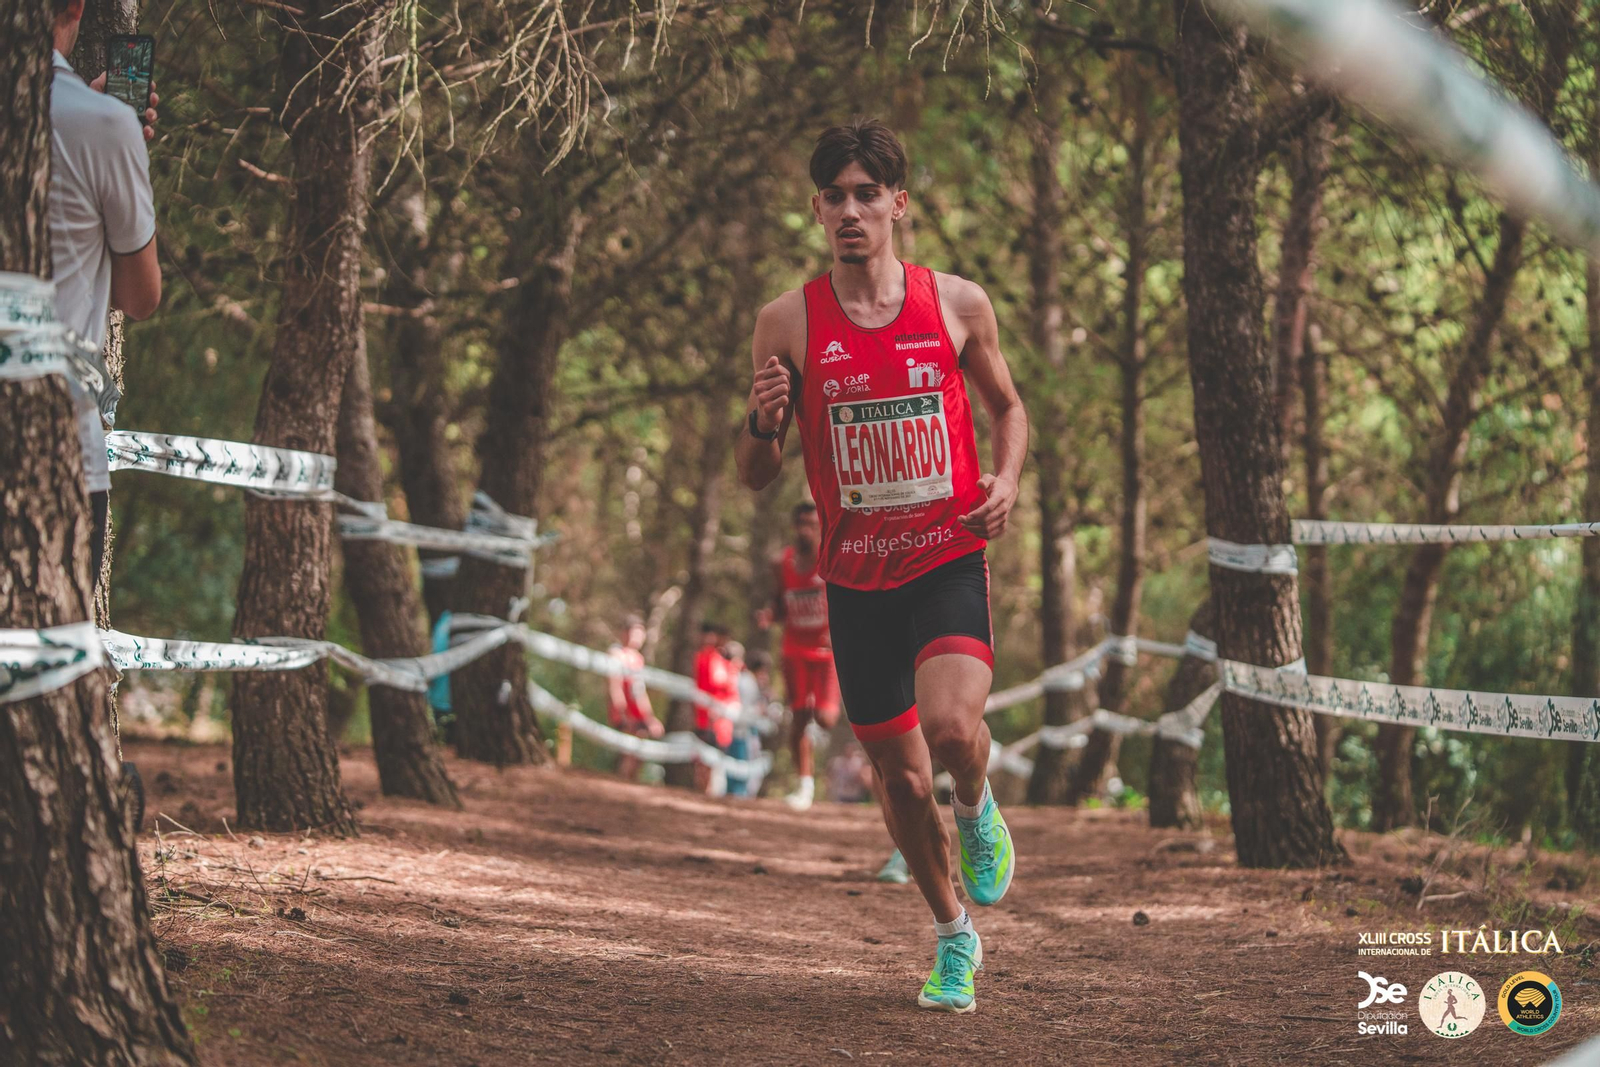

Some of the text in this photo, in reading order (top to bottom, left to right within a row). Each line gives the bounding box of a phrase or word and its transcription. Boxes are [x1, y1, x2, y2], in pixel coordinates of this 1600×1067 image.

[894, 331, 939, 342] Atletismo
[895, 340, 941, 351] Numantino
[820, 353, 853, 364] austral
[861, 402, 914, 419] ITÁLICA
[833, 415, 947, 487] LEONARDO
[841, 526, 954, 558] #eligeSoria
